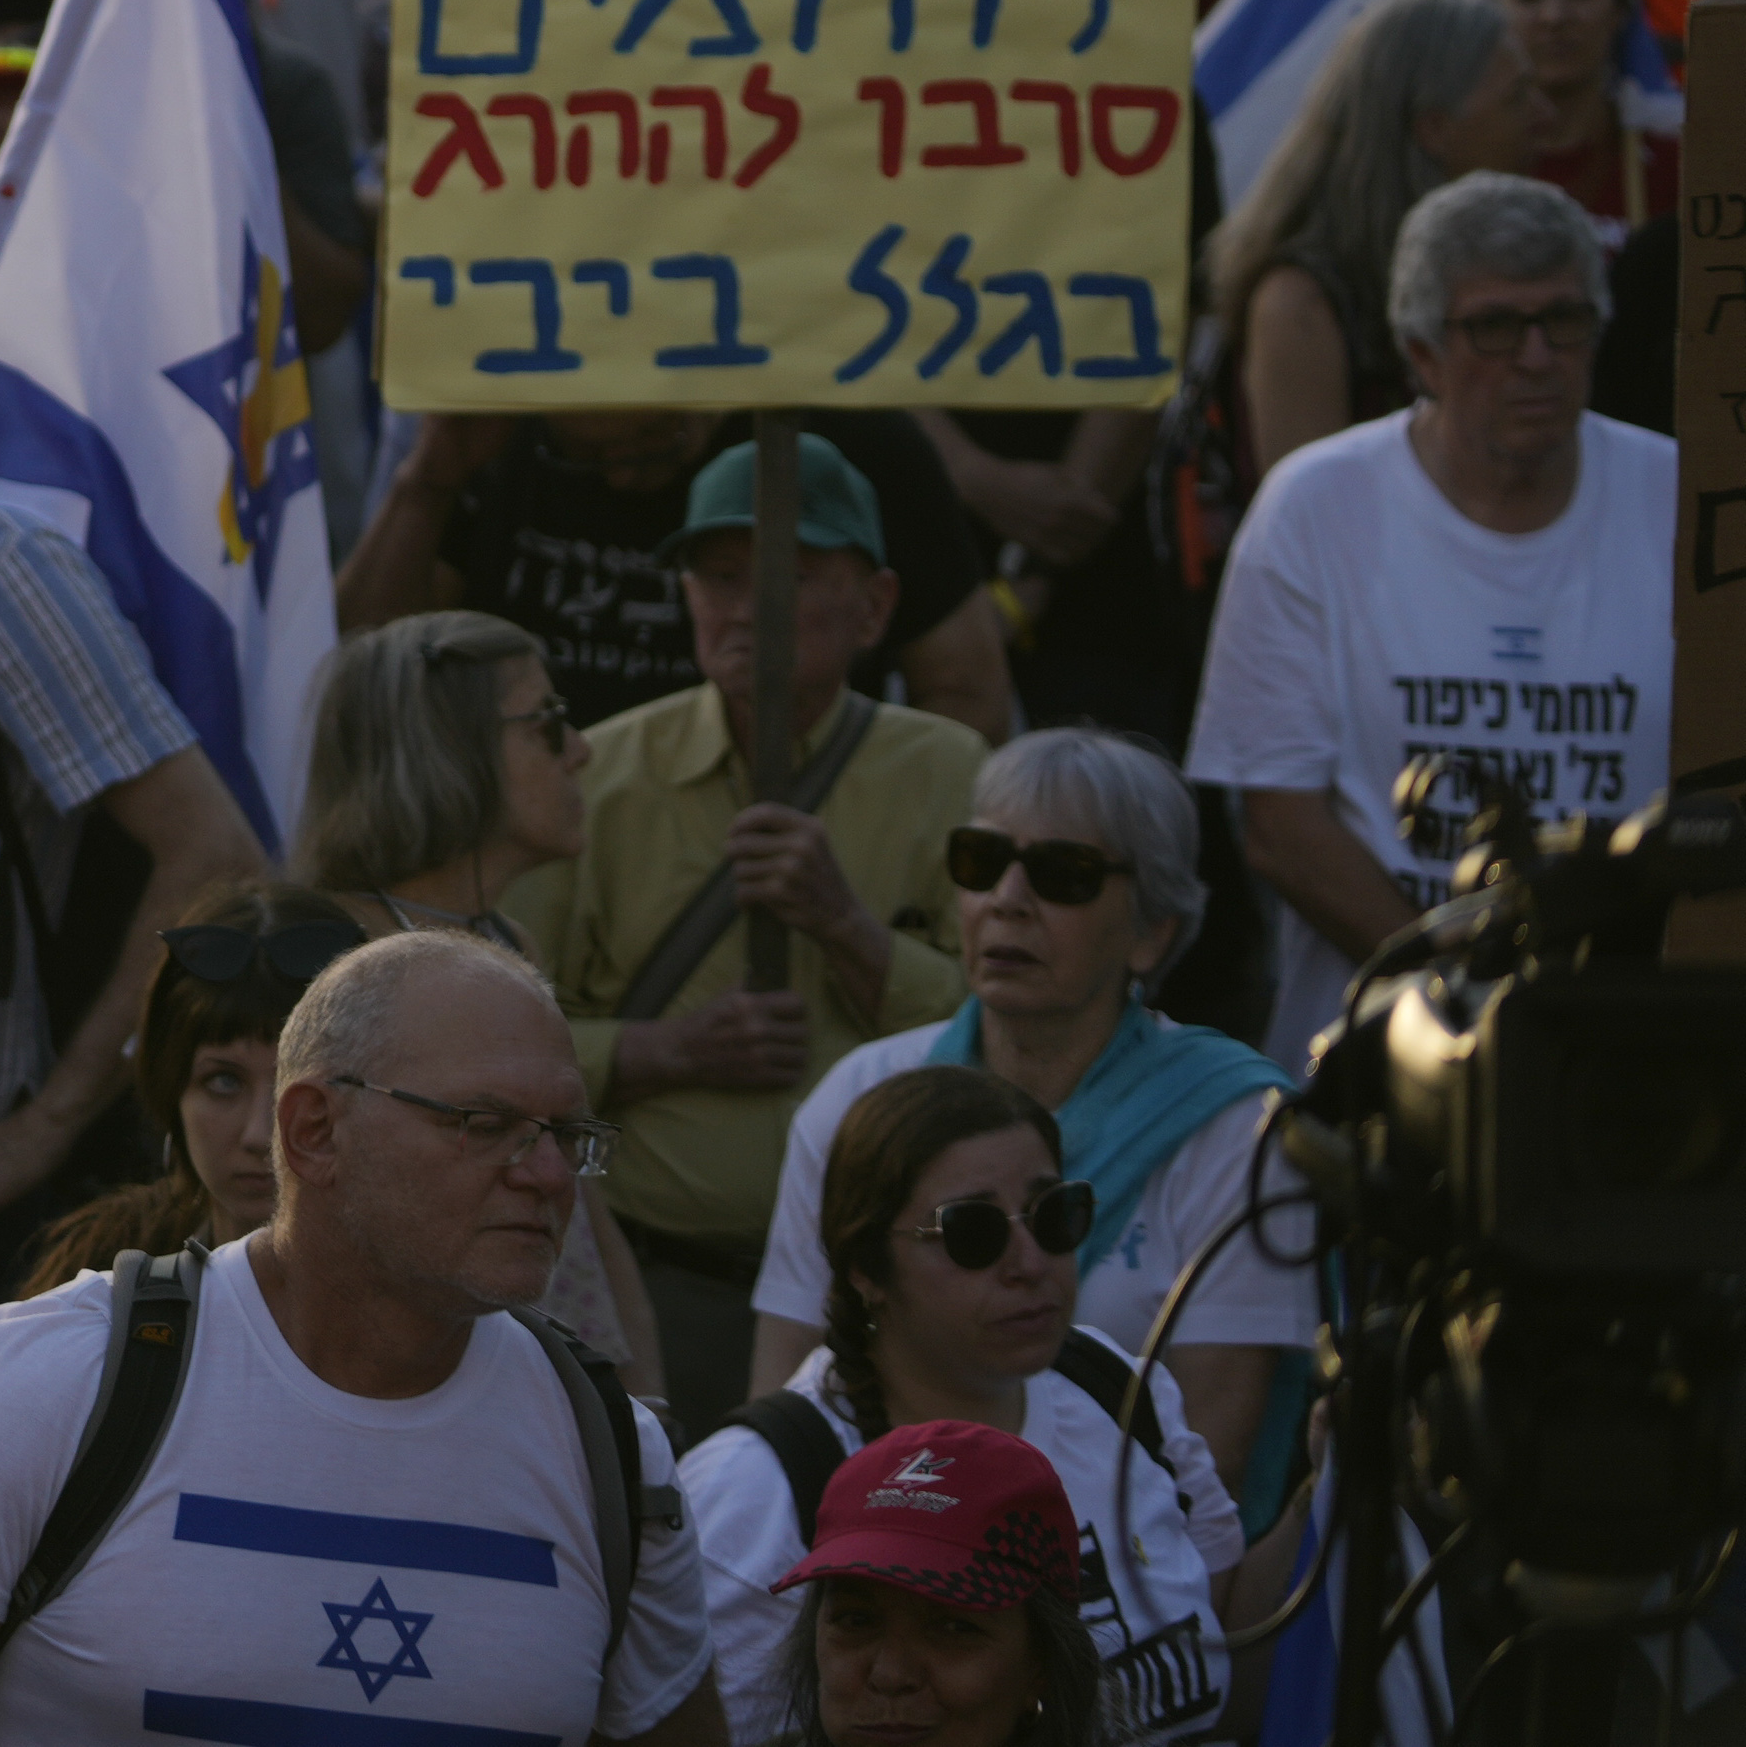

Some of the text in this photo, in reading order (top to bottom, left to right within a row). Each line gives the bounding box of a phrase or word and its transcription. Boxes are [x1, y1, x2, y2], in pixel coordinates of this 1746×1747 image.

[411, 62, 1181, 199] סרבו לההרג
[399, 224, 1175, 384] בגלל ביבי
[1393, 672, 1639, 734] לוחמי כיפור
